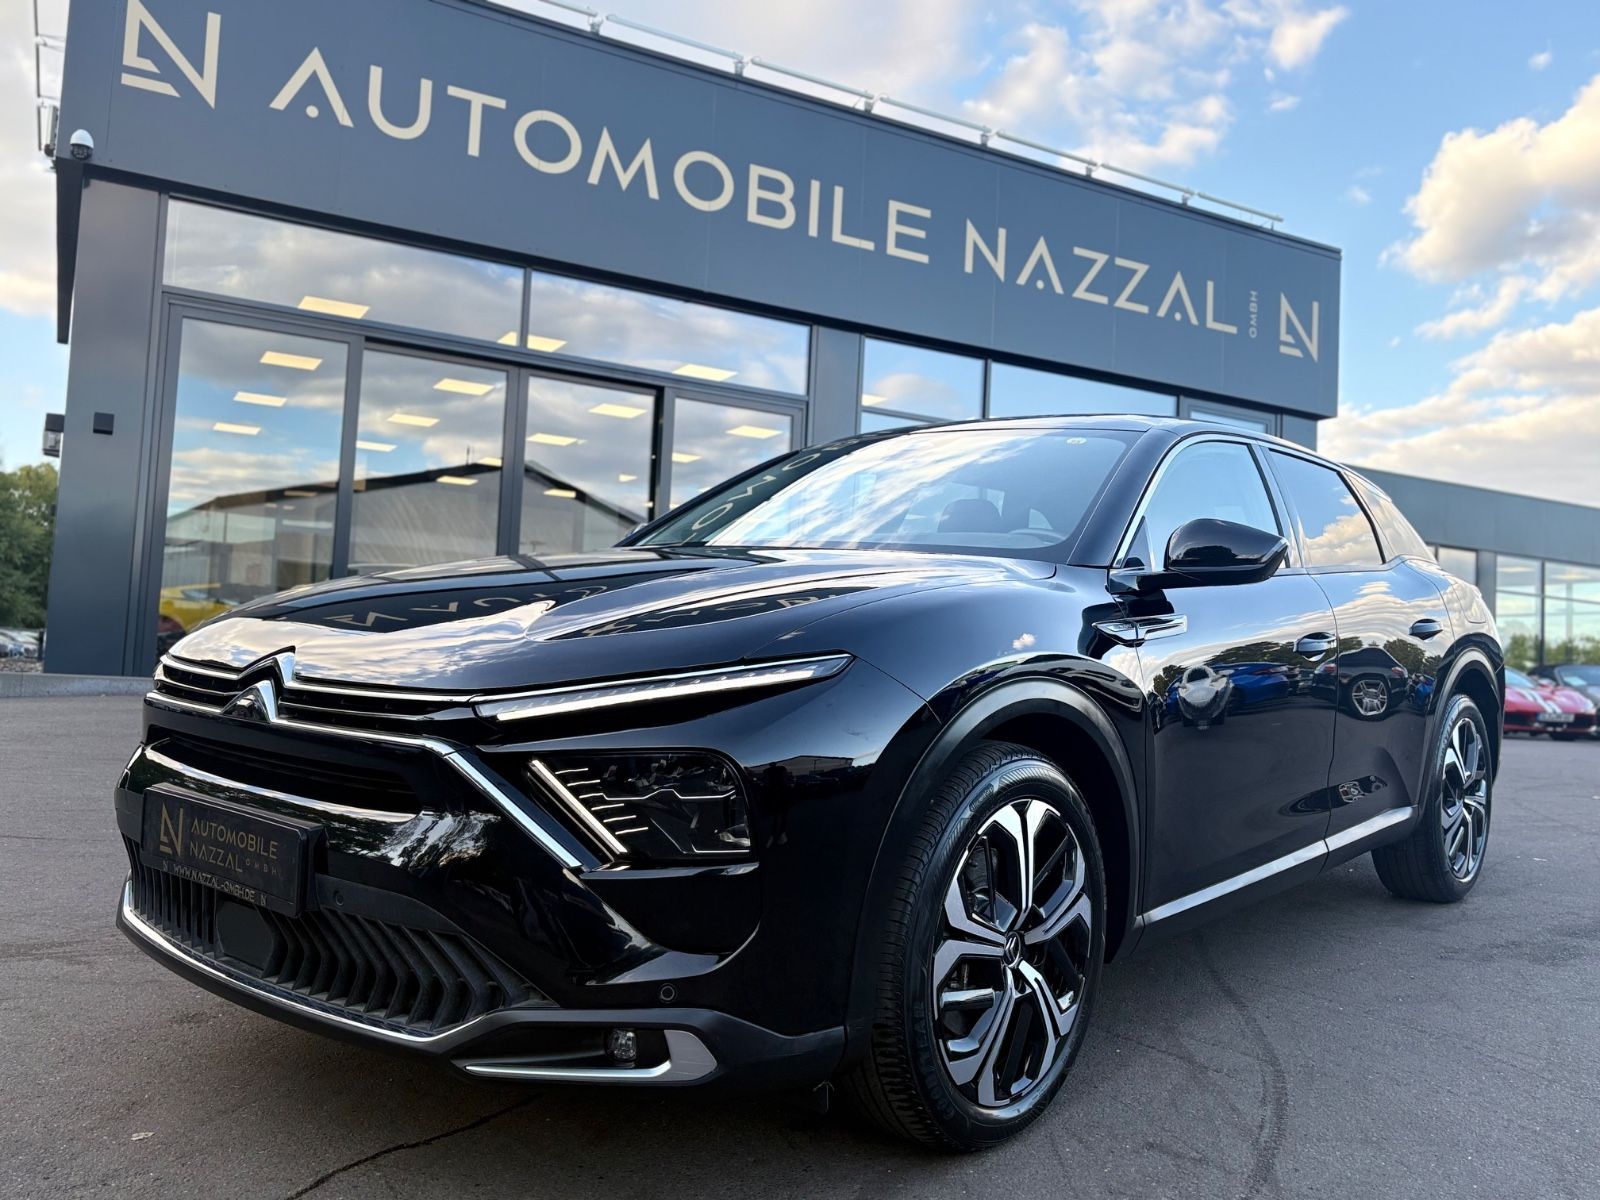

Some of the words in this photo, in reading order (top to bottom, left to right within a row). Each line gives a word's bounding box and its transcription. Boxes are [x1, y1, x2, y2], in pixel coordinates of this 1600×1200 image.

[269, 47, 931, 265] AUTOMOBILE
[964, 218, 1238, 334] NAZZAL
[1248, 290, 1259, 339] GMBH
[189, 841, 243, 873] NAZZAL
[191, 818, 278, 858] AUTOMOBILE
